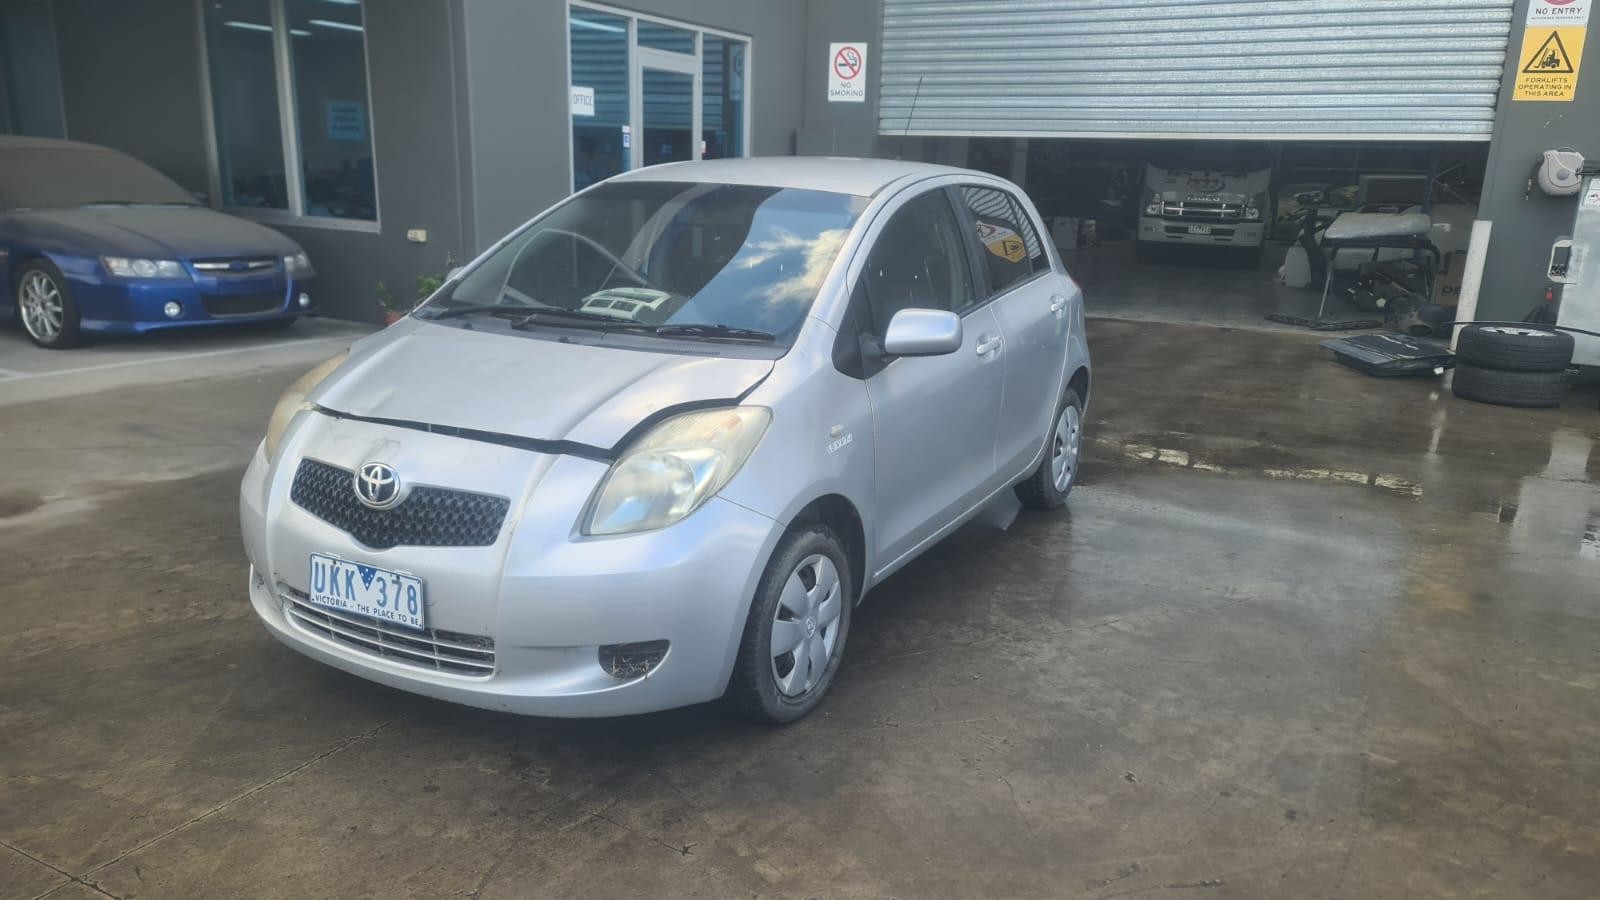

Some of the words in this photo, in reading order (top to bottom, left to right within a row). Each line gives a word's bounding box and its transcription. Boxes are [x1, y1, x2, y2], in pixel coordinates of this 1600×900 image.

[1535, 7, 1548, 15] NO
[1551, 7, 1583, 15] ENTRY
[840, 81, 852, 89] NO
[830, 89, 864, 97] SMOKING
[573, 94, 593, 106] OFFICE
[314, 561, 356, 601] UKK
[376, 576, 418, 616] 378
[315, 594, 347, 608] VICTORIA
[357, 603, 370, 614] THE
[373, 608, 395, 620] PLACE
[398, 613, 407, 623] TO
[410, 618, 419, 626] BE
